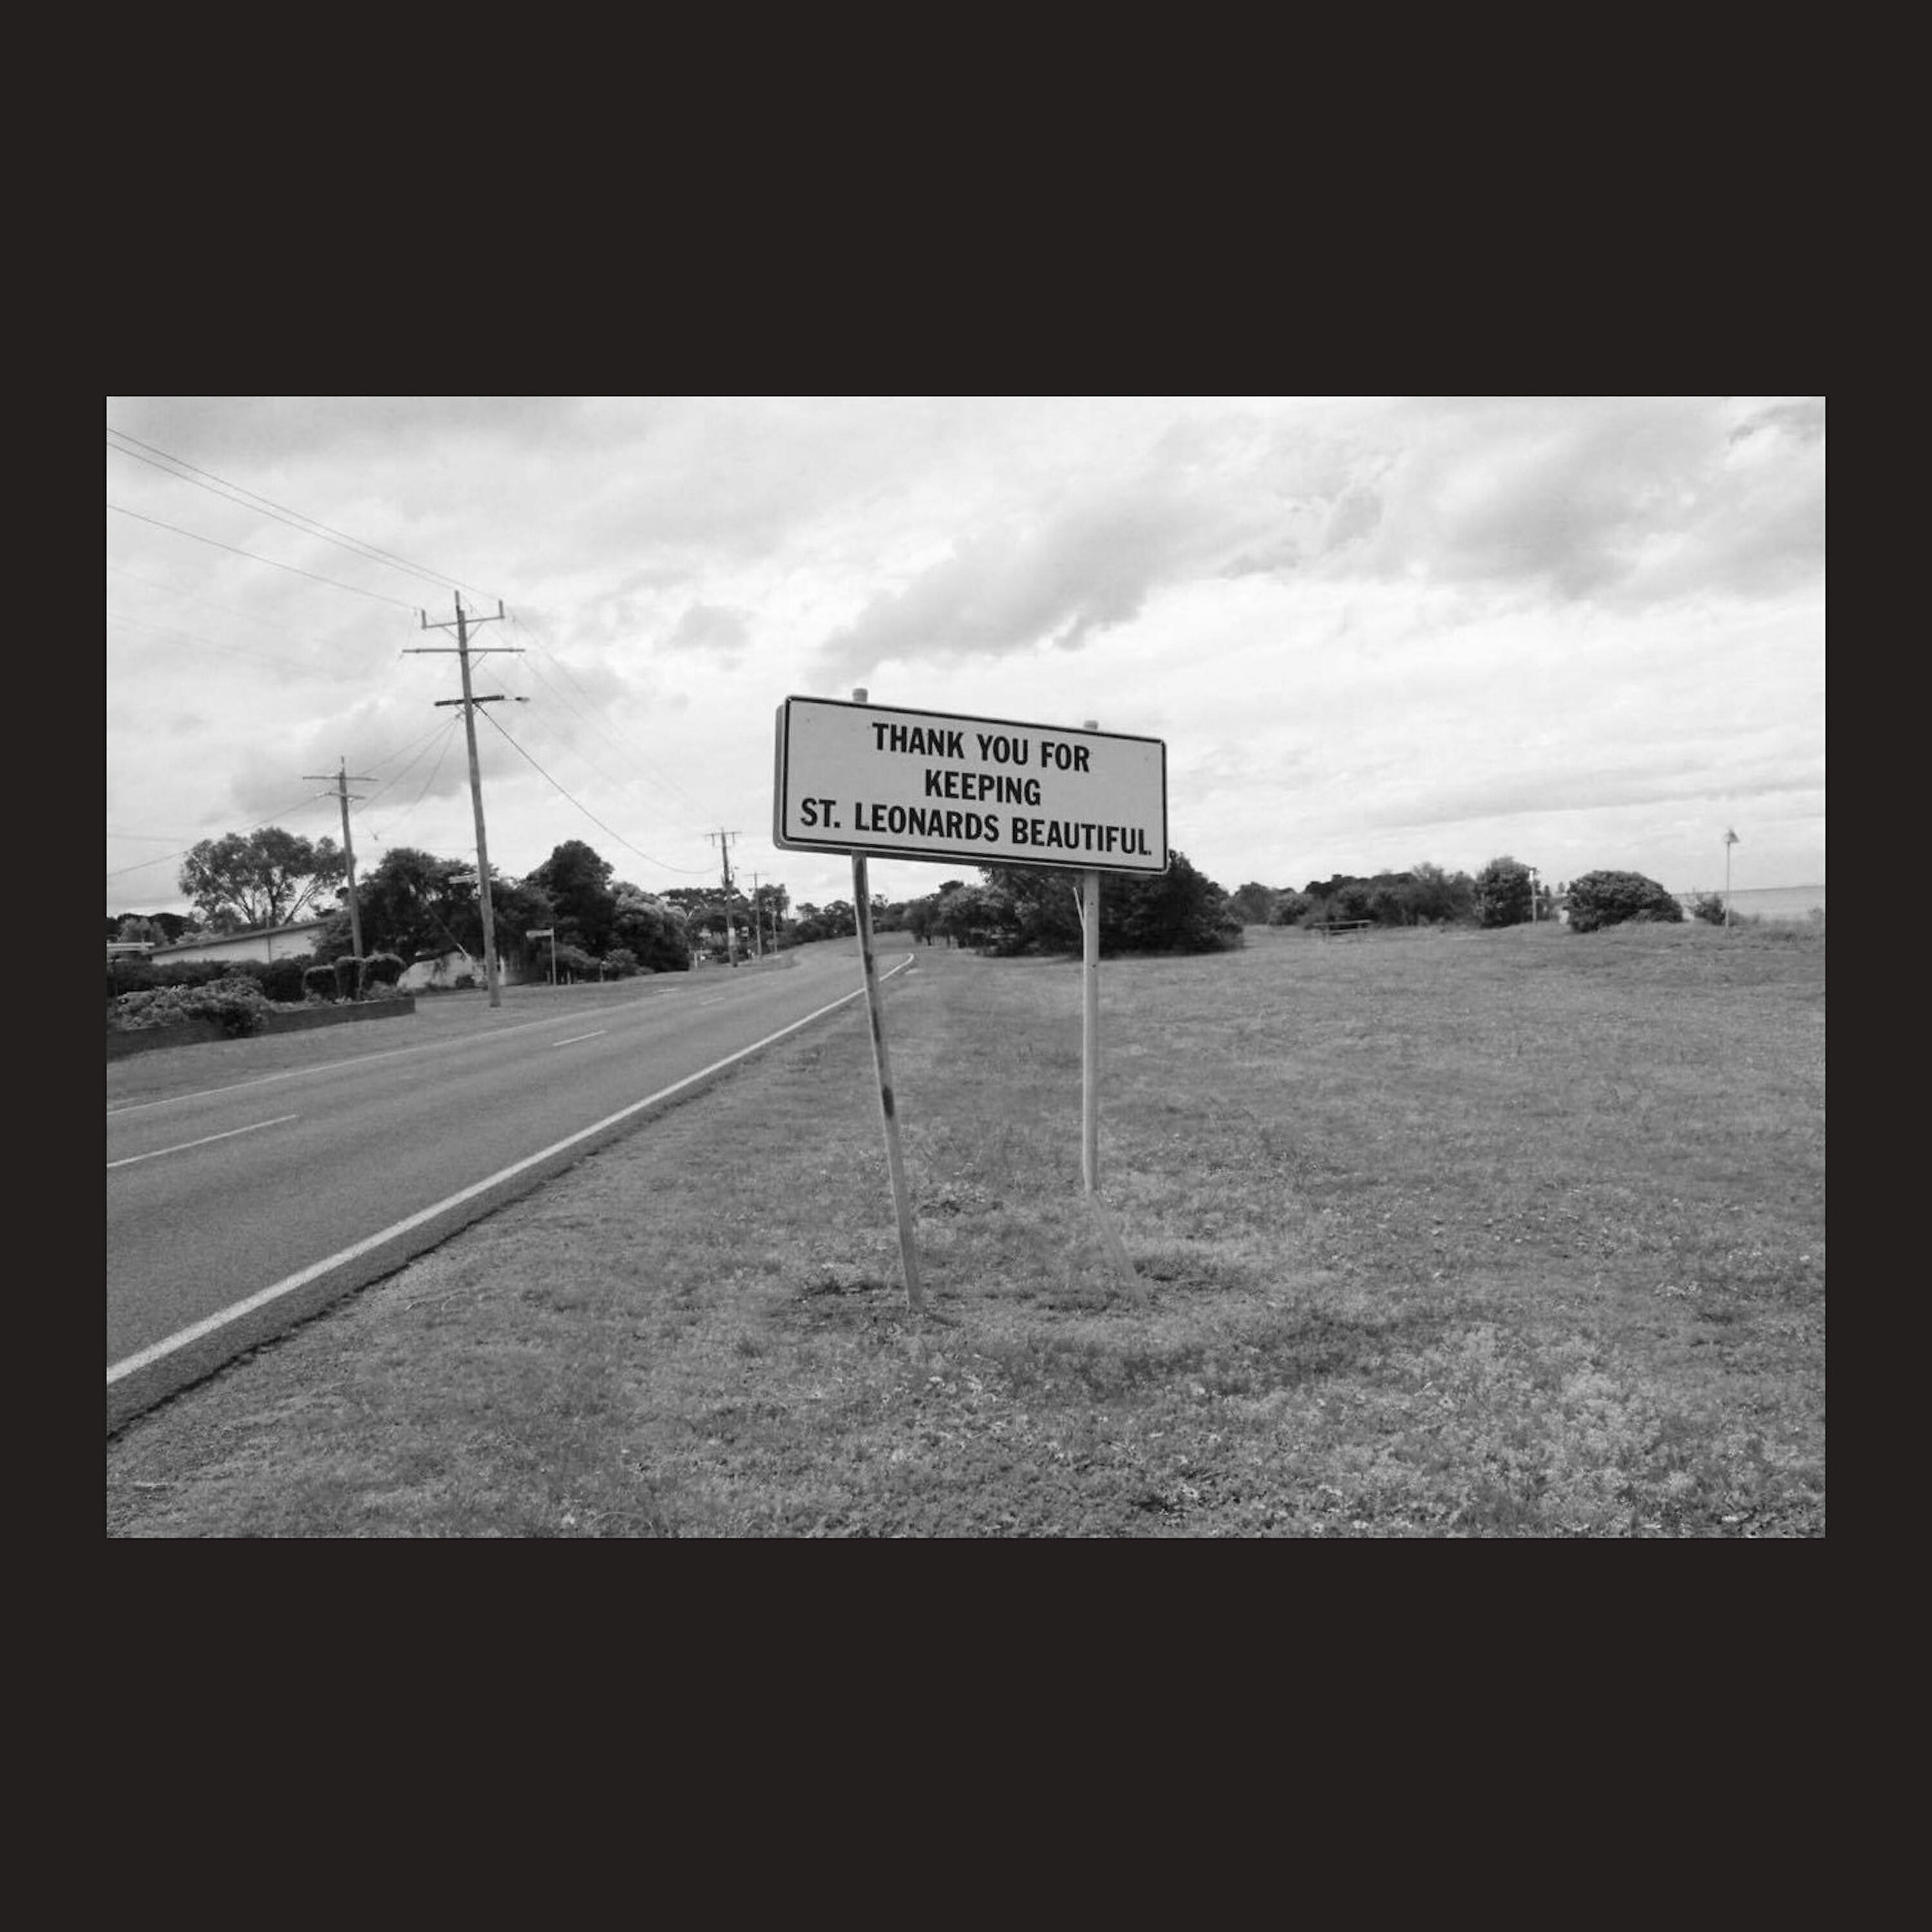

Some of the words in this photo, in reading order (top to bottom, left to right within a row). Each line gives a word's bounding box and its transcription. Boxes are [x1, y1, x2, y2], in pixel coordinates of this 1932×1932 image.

[871, 722, 965, 757] THANK
[976, 734, 1028, 766] YOU
[1041, 741, 1091, 773] FOR
[925, 768, 1041, 806] KEEPING
[800, 797, 841, 829] ST.
[855, 802, 999, 842] LEONARDS
